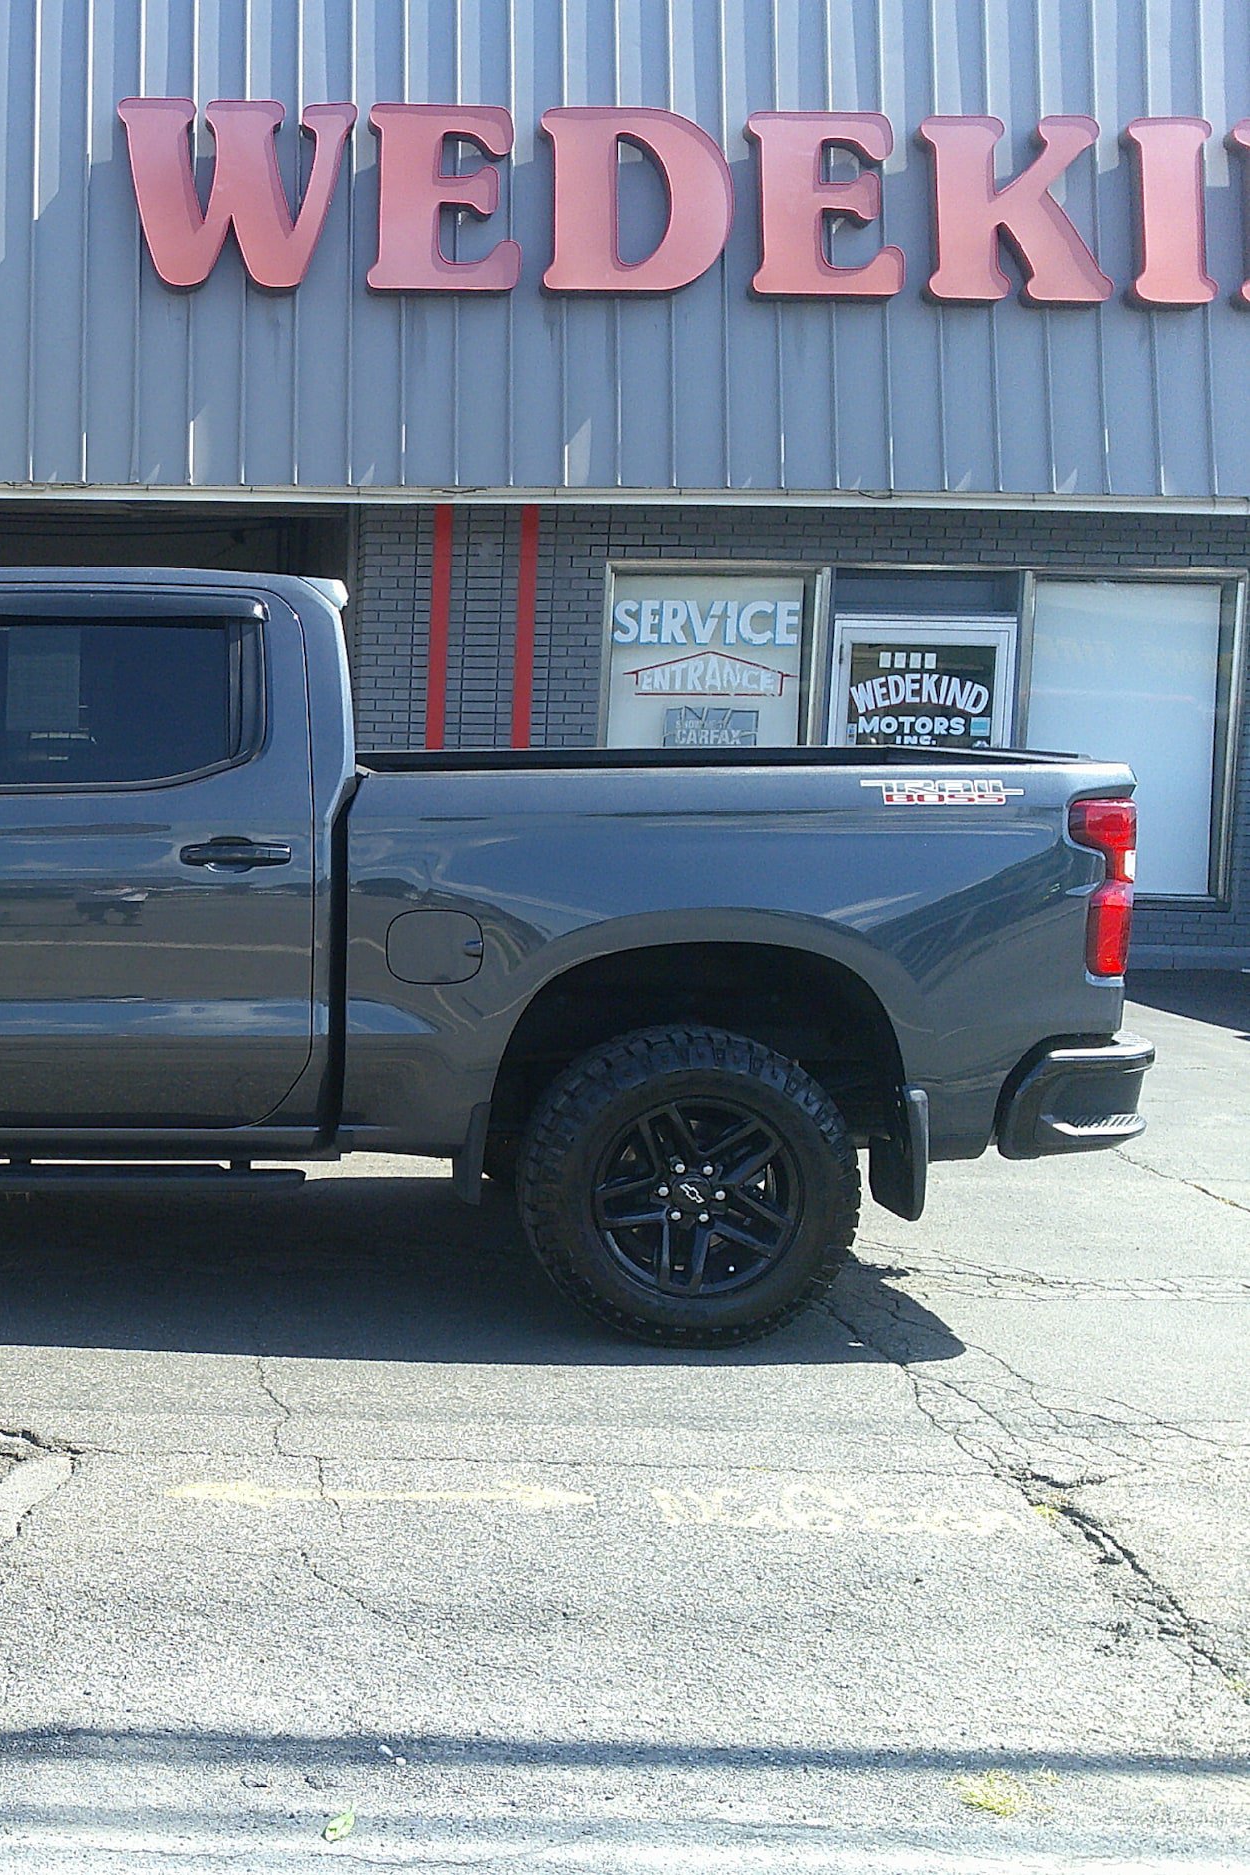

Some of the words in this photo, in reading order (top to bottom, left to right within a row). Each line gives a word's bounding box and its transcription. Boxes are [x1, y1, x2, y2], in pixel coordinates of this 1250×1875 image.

[118, 97, 1250, 306] WEDEKI
[613, 600, 800, 646] SERVICE
[641, 655, 776, 691] ENTRANCE
[850, 673, 989, 714] WEDEKIND
[675, 729, 742, 745] CARFAX
[858, 715, 966, 735] MOTORS
[860, 779, 1024, 796] TRAIL
[883, 793, 1007, 805] BOSS
